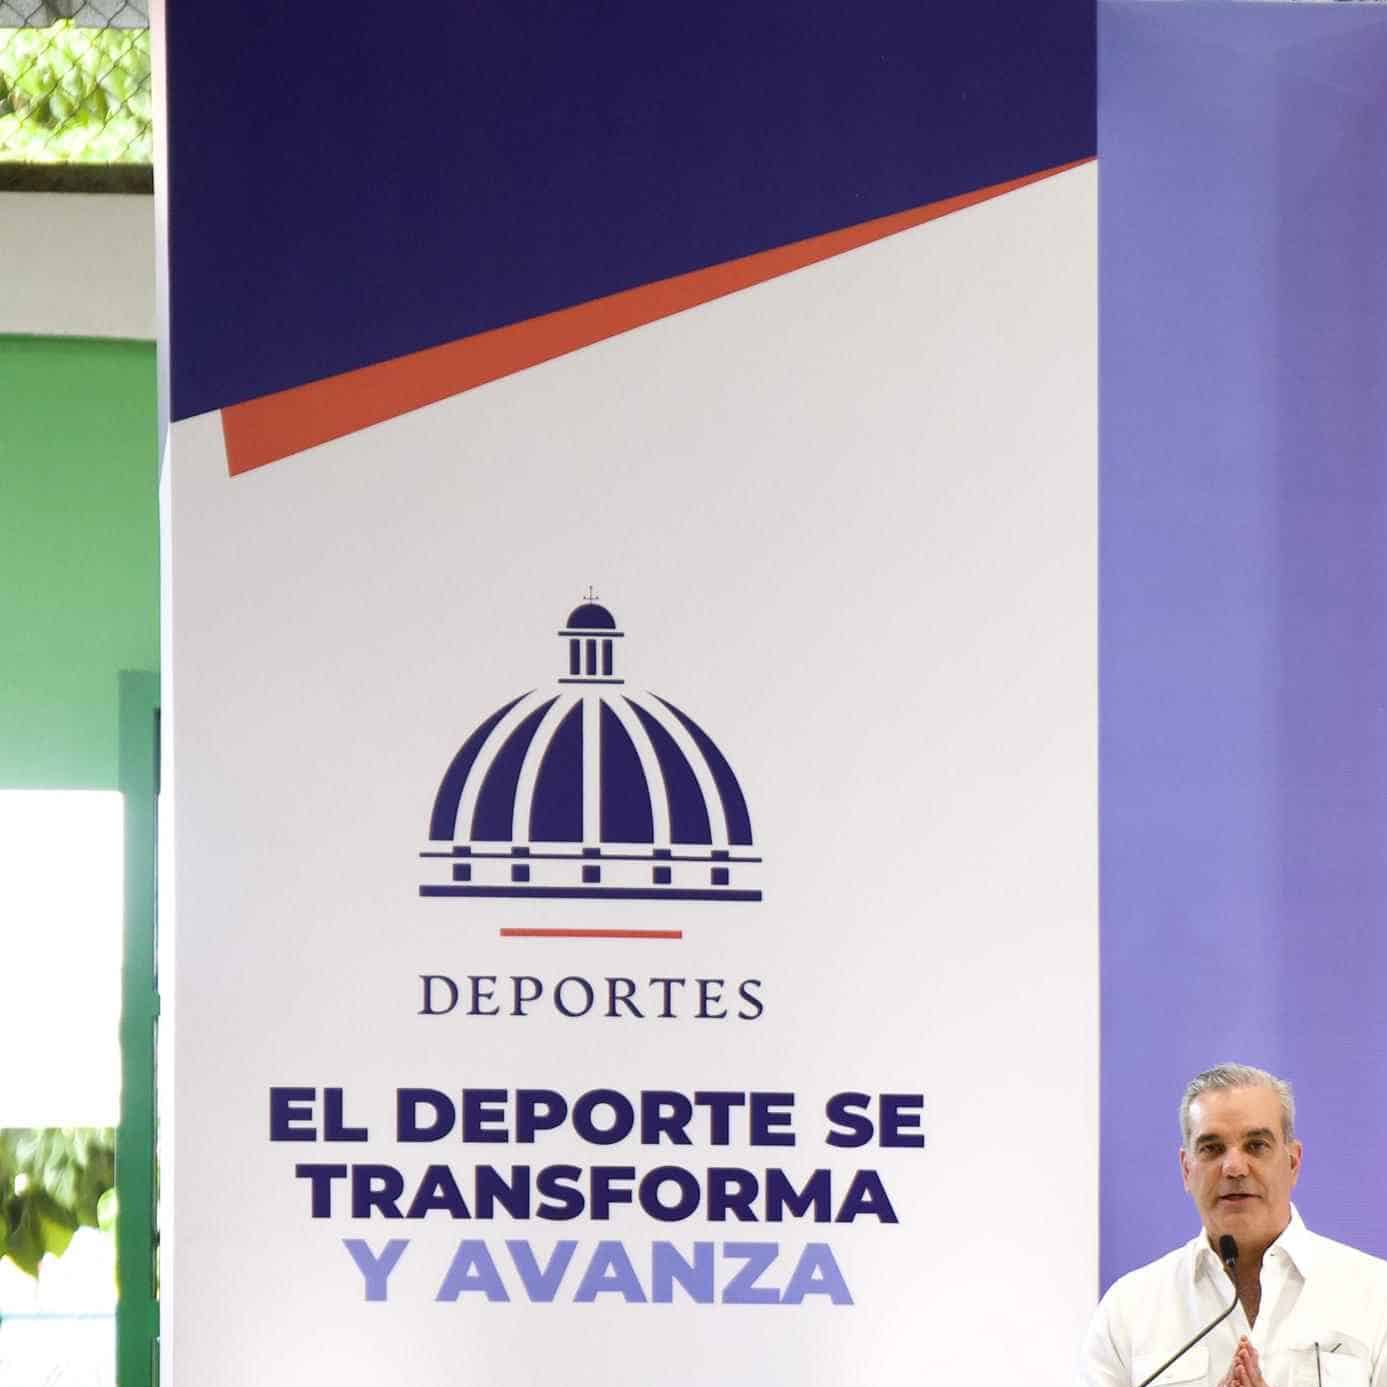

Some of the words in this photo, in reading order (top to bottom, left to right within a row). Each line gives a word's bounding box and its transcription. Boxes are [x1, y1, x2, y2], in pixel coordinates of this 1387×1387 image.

[418, 975, 764, 1020] DEPORTES
[269, 1086, 369, 1143] EL
[396, 1087, 796, 1147] DEPORTE
[825, 1091, 925, 1149] SE
[295, 1163, 899, 1224] TRANSFORMA
[342, 1238, 411, 1301] Y
[435, 1239, 855, 1305] AVANZA
